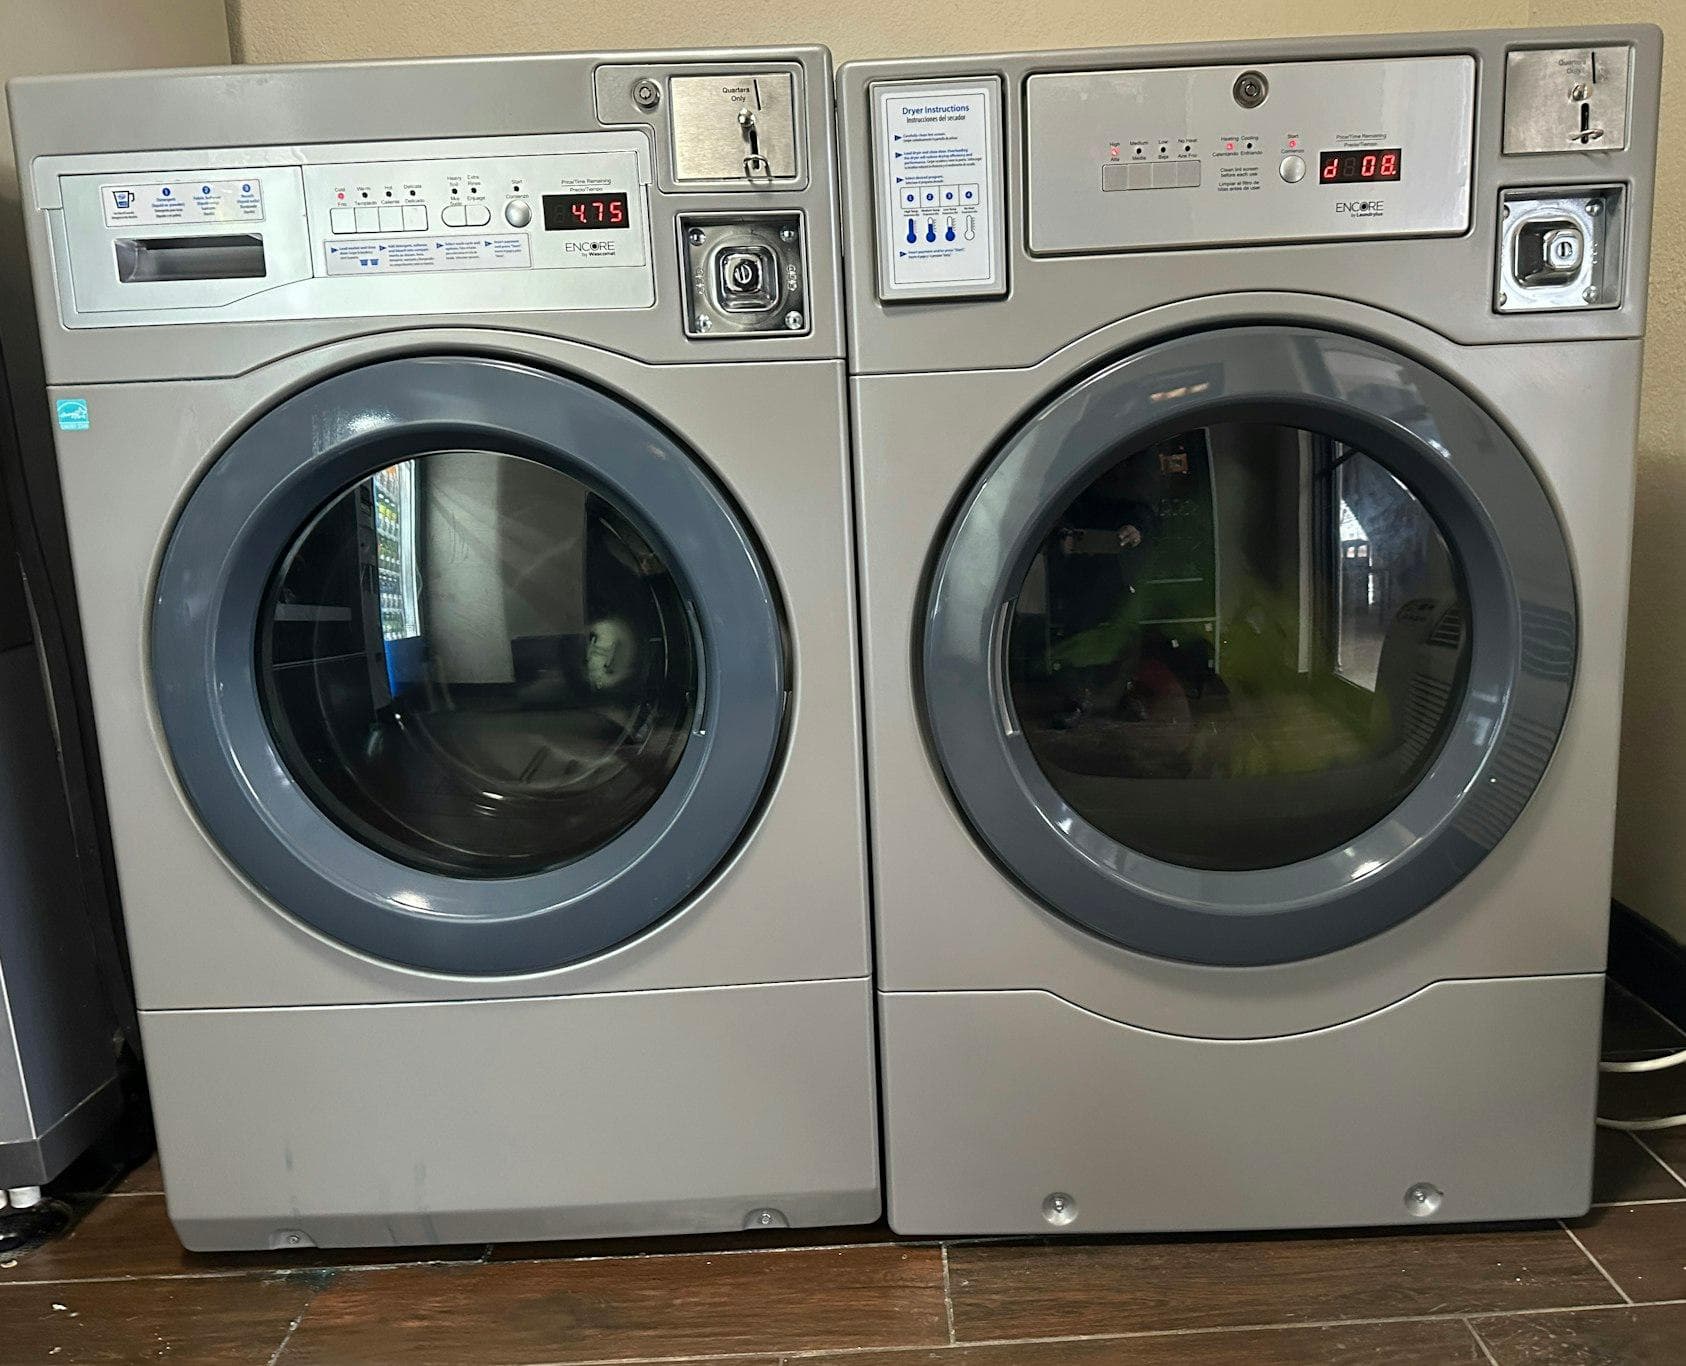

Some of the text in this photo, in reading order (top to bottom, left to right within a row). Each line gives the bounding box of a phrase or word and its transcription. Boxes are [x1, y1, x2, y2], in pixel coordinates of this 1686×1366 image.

[902, 105, 970, 116] Dryer Instructions
[938, 114, 946, 122] del
[571, 201, 622, 223] 4.75
[1335, 200, 1385, 213] ENCORE
[565, 241, 616, 252] ENCORE
